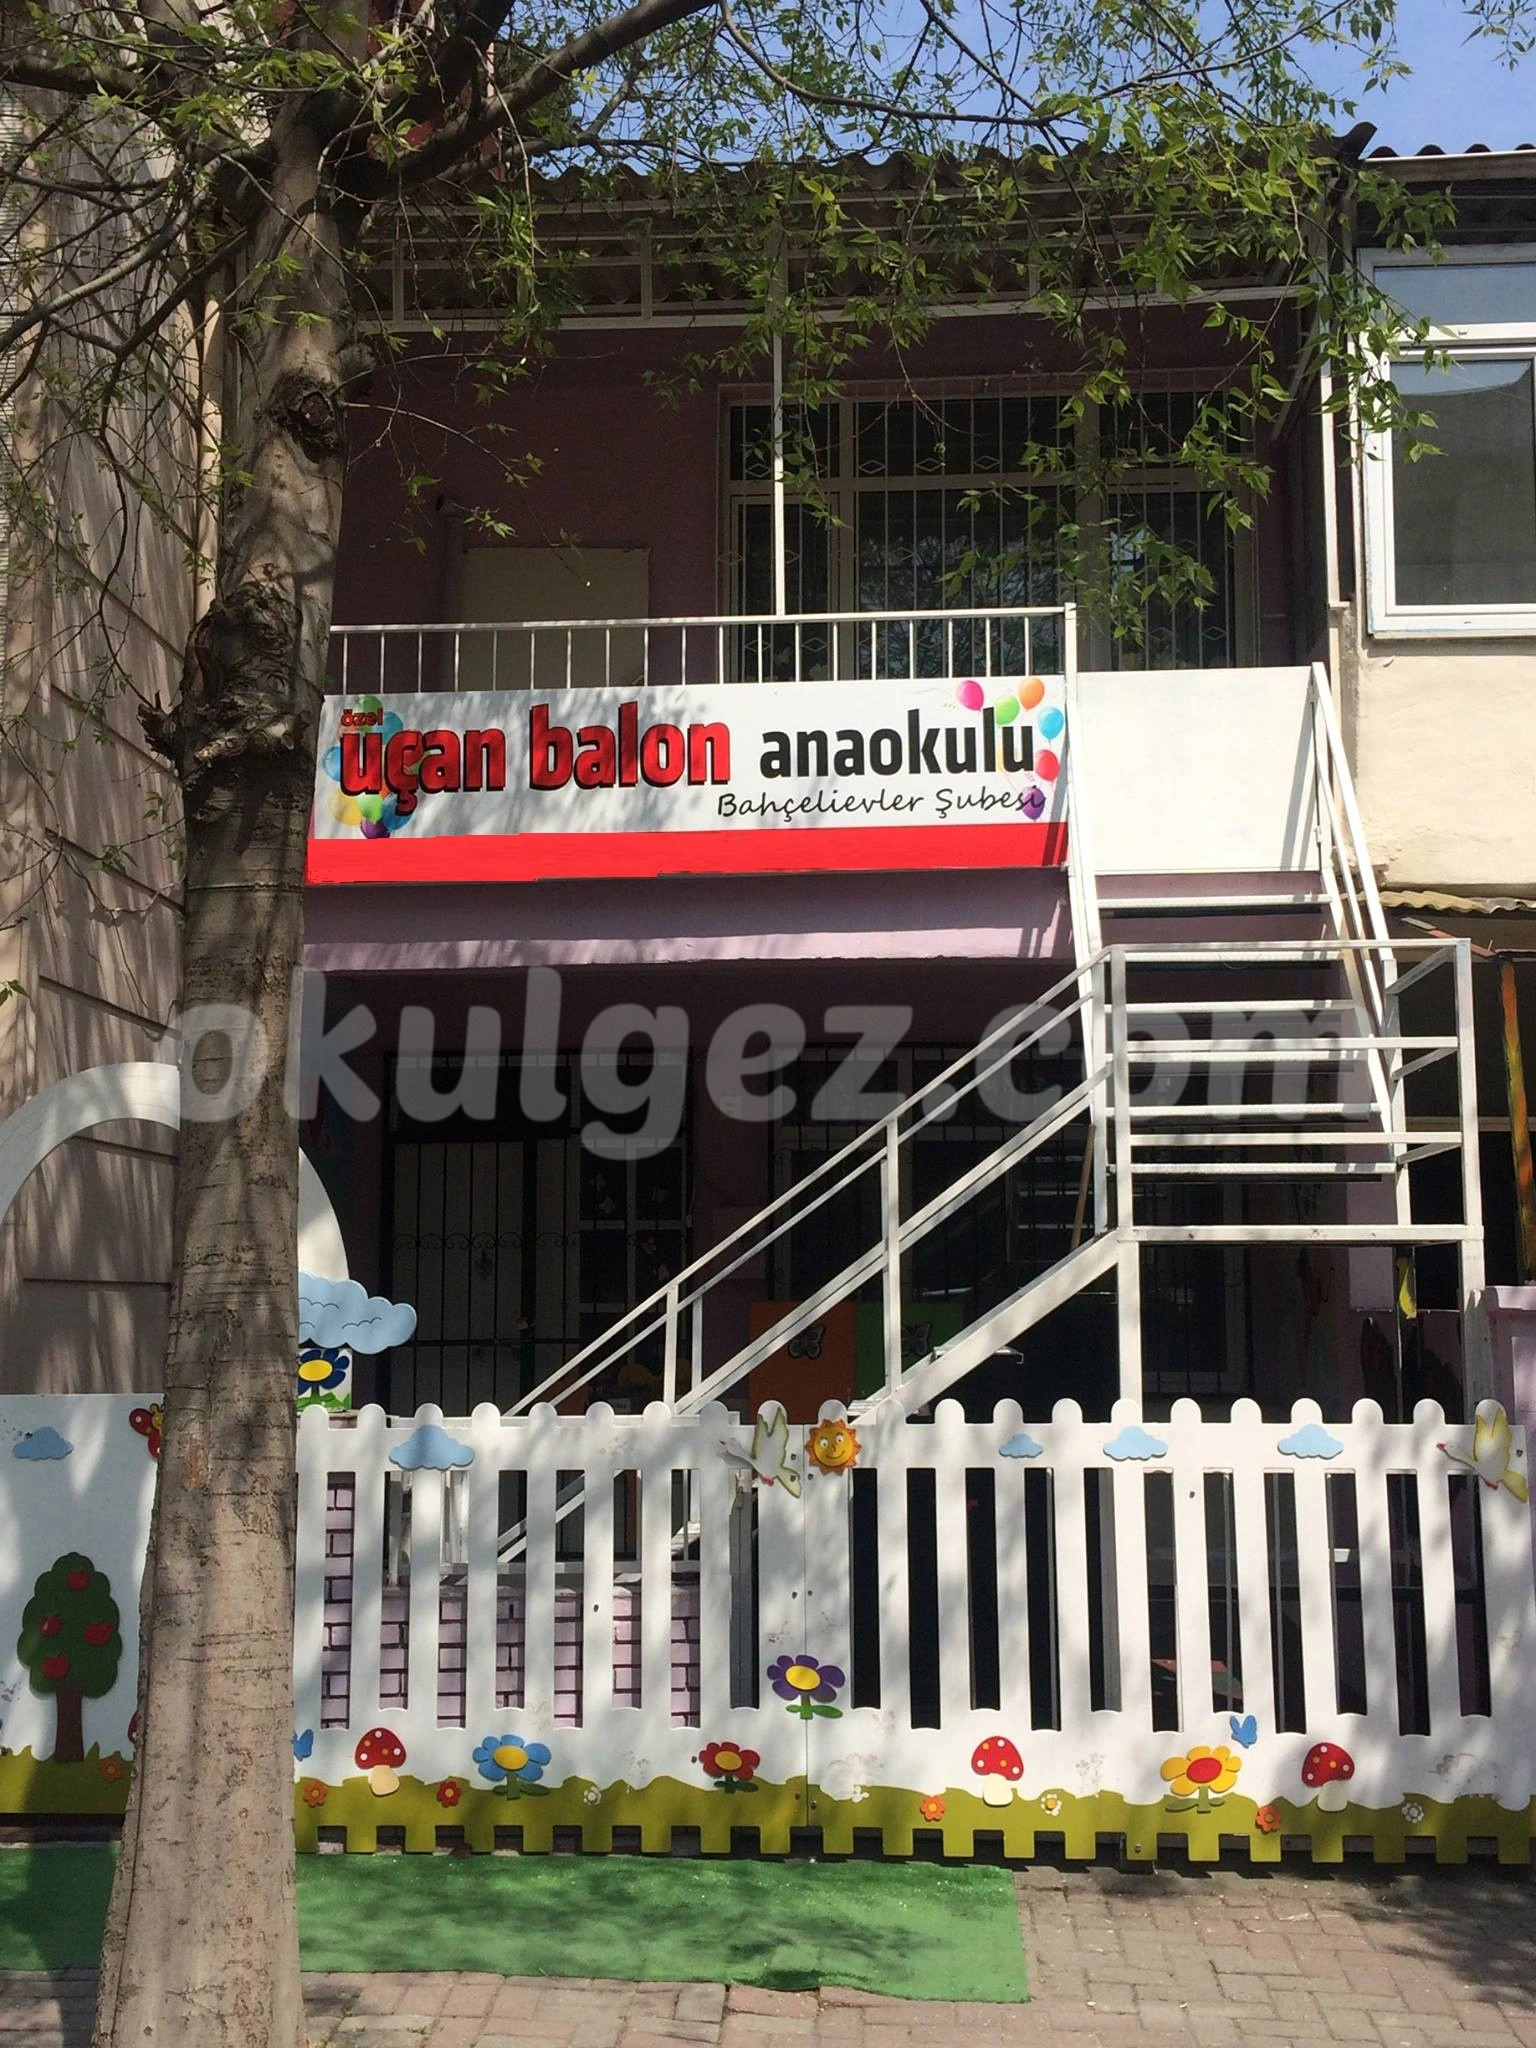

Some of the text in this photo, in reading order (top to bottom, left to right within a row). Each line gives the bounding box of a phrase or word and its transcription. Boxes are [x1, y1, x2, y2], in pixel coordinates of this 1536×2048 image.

[341, 708, 383, 726] özel
[529, 701, 730, 790] balon
[760, 707, 1034, 778] anaokulu
[717, 785, 1046, 822] Bahçelievler Şubesi
